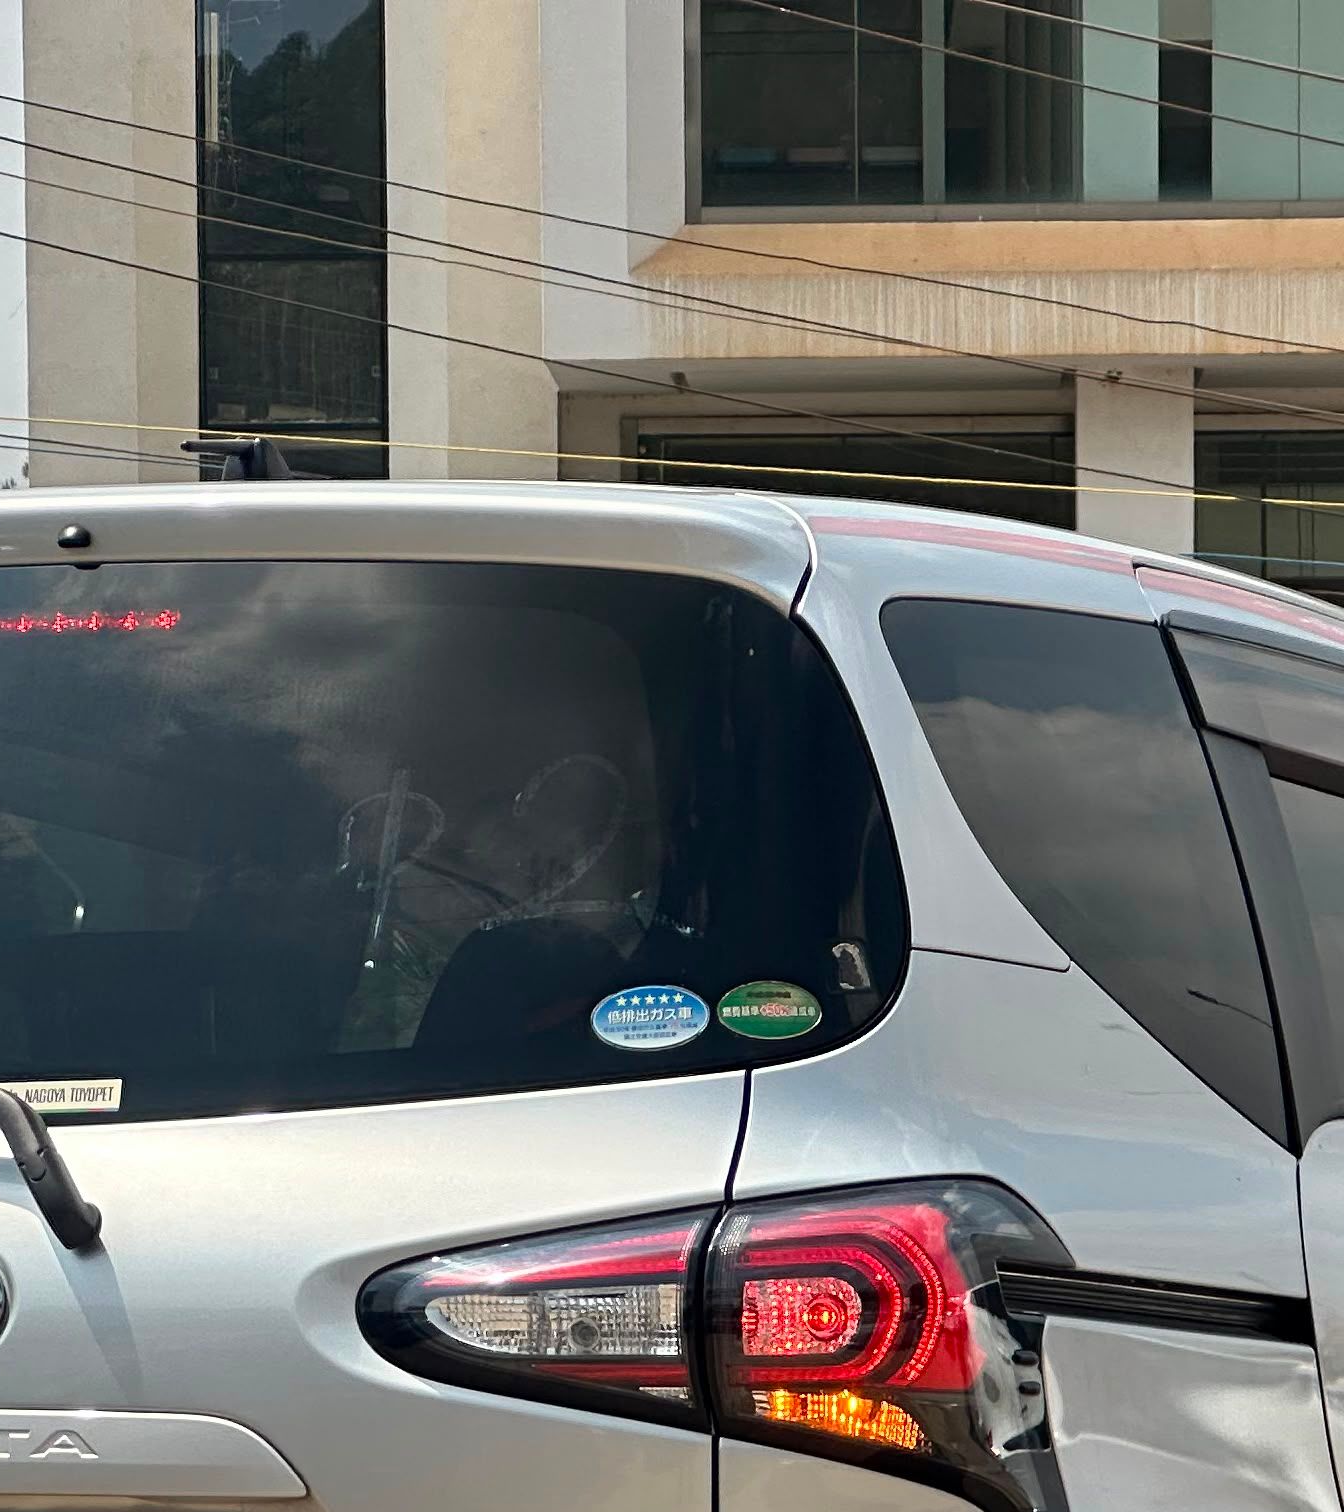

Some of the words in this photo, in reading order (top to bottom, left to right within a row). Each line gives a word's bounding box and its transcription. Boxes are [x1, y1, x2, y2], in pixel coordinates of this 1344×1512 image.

[607, 1006, 693, 1025] 低排出ガス車
[24, 1087, 66, 1103] NAGOYA
[70, 1086, 114, 1102] TOYOPET
